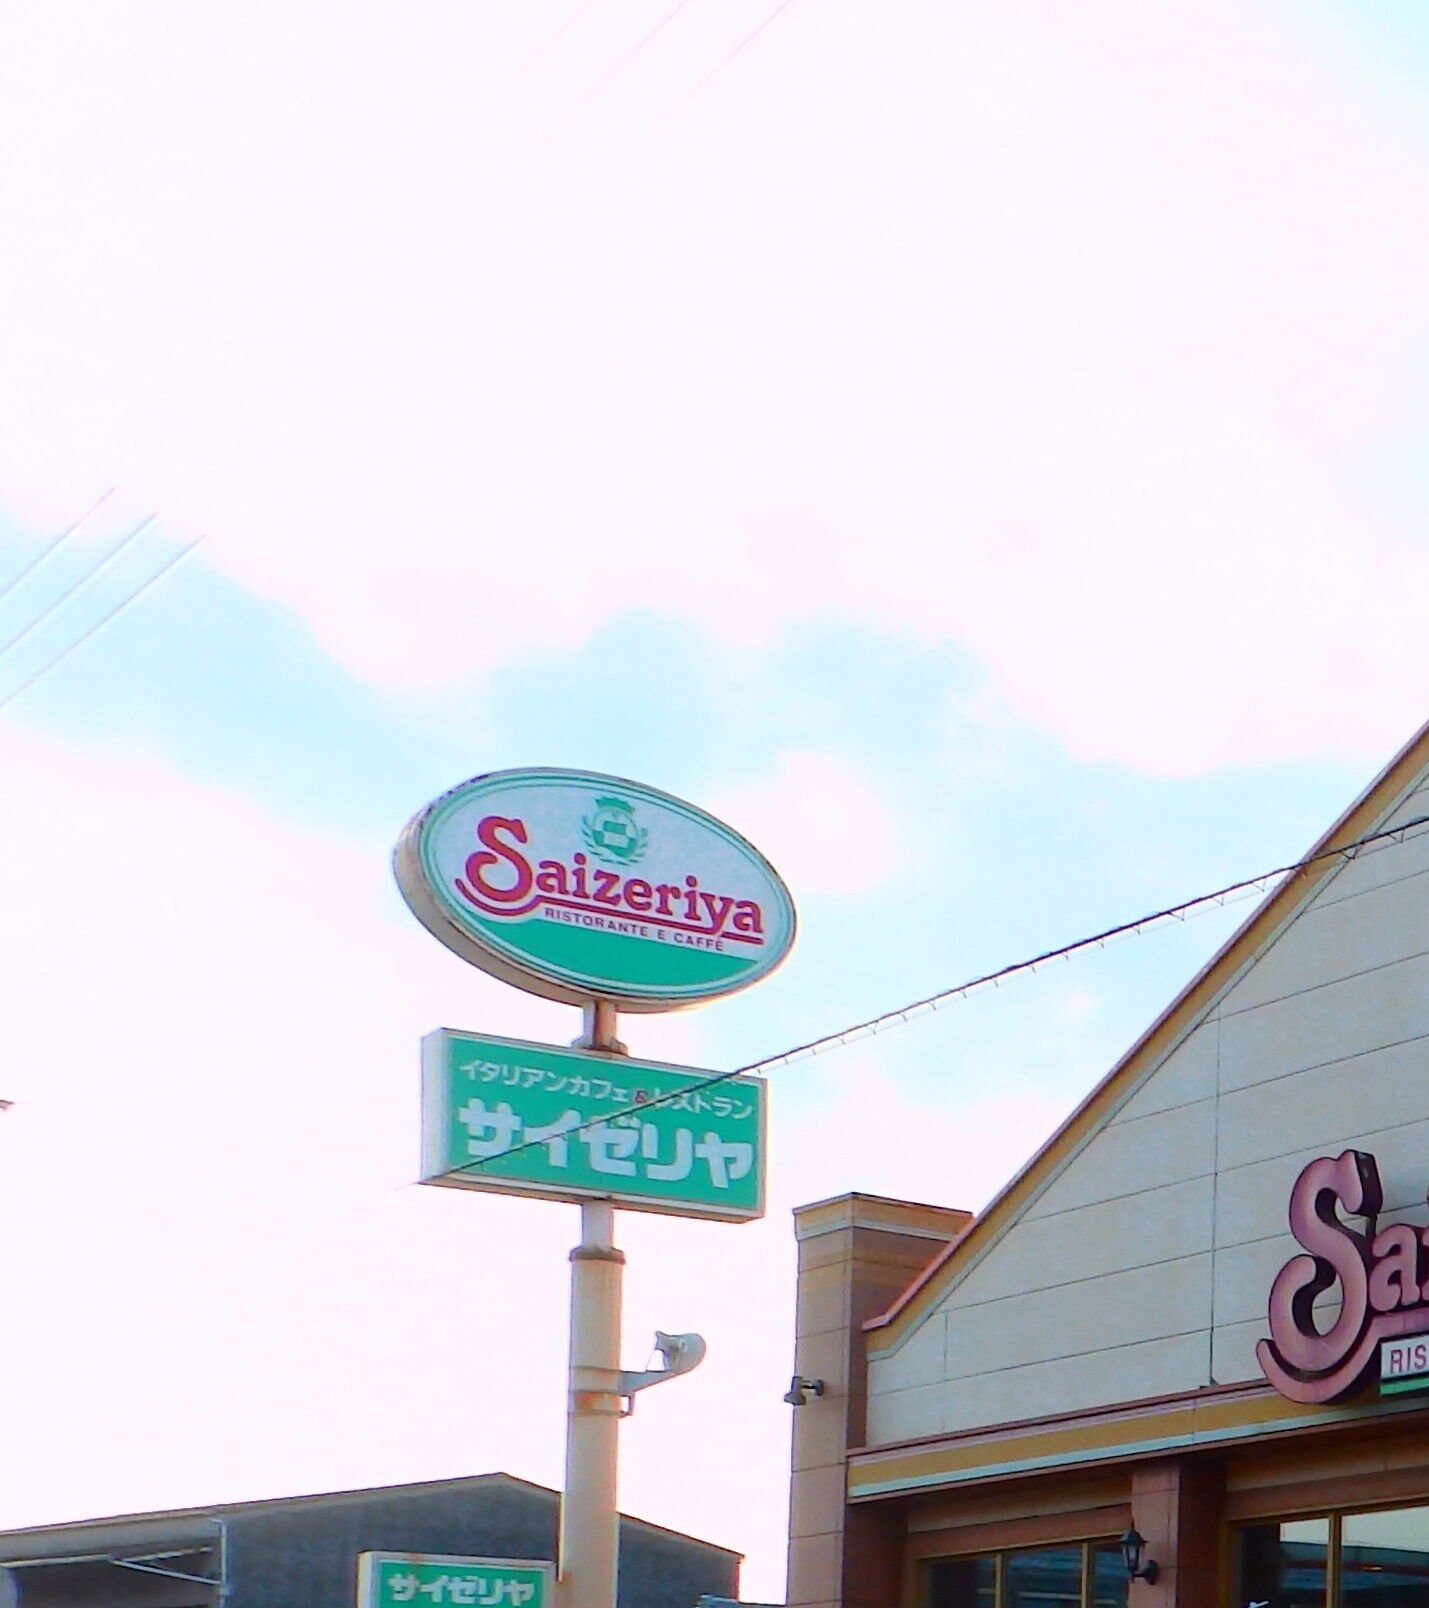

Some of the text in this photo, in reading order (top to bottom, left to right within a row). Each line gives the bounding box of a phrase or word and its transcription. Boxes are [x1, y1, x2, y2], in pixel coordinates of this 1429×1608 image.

[456, 815, 764, 943] Saizeriya
[545, 907, 648, 937] RISTORANTE
[657, 929, 666, 940] E
[456, 1096, 754, 1188] サイゼリヤ
[387, 1572, 536, 1607] サイゼリヤ
